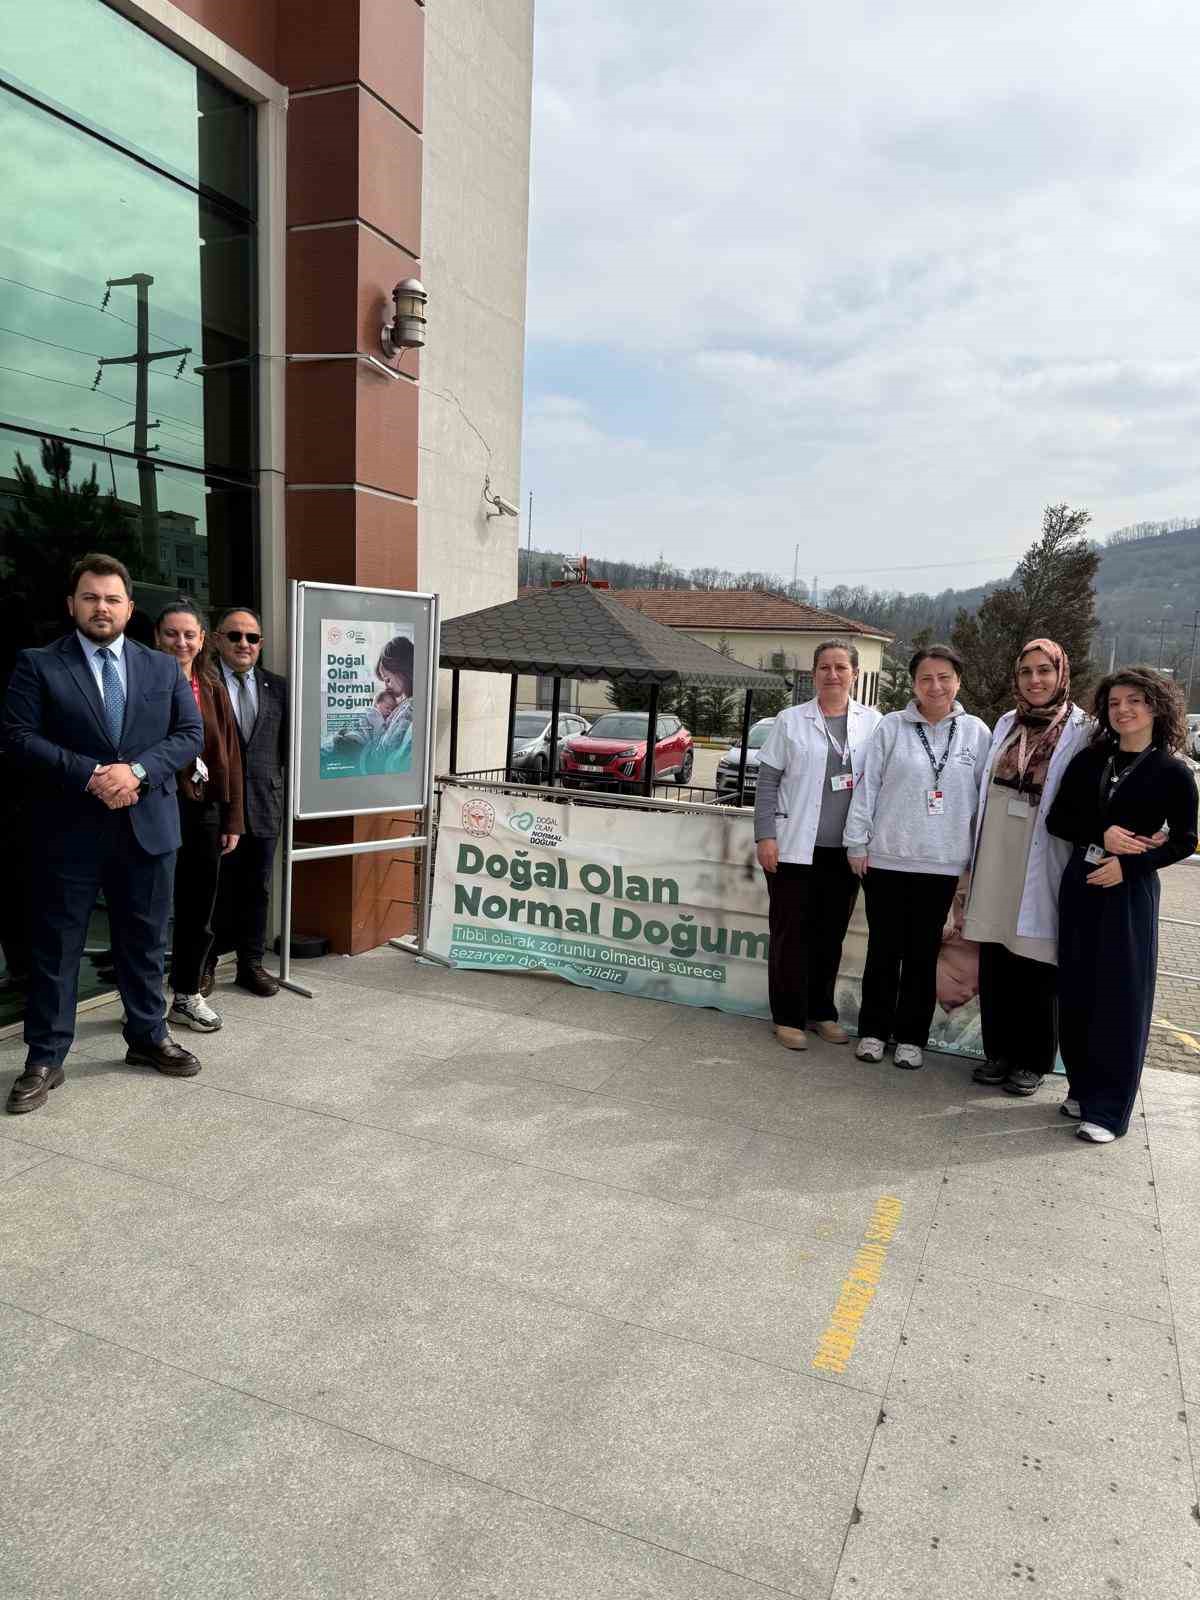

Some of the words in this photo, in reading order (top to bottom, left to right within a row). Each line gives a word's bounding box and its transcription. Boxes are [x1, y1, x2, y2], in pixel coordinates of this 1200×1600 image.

[327, 654, 365, 668] Doğal
[327, 668, 358, 680] Olan
[327, 682, 375, 694] Normal
[327, 695, 374, 709] Doğum
[531, 831, 563, 841] NORMAL
[456, 843, 569, 891] Doğal
[579, 862, 680, 905] Olan
[453, 883, 601, 936] Normal
[612, 907, 770, 960] Doğum
[450, 948, 515, 963] sezaryen
[491, 932, 536, 949] olarak
[540, 939, 596, 958] zorunlu
[668, 960, 722, 980] sürece
